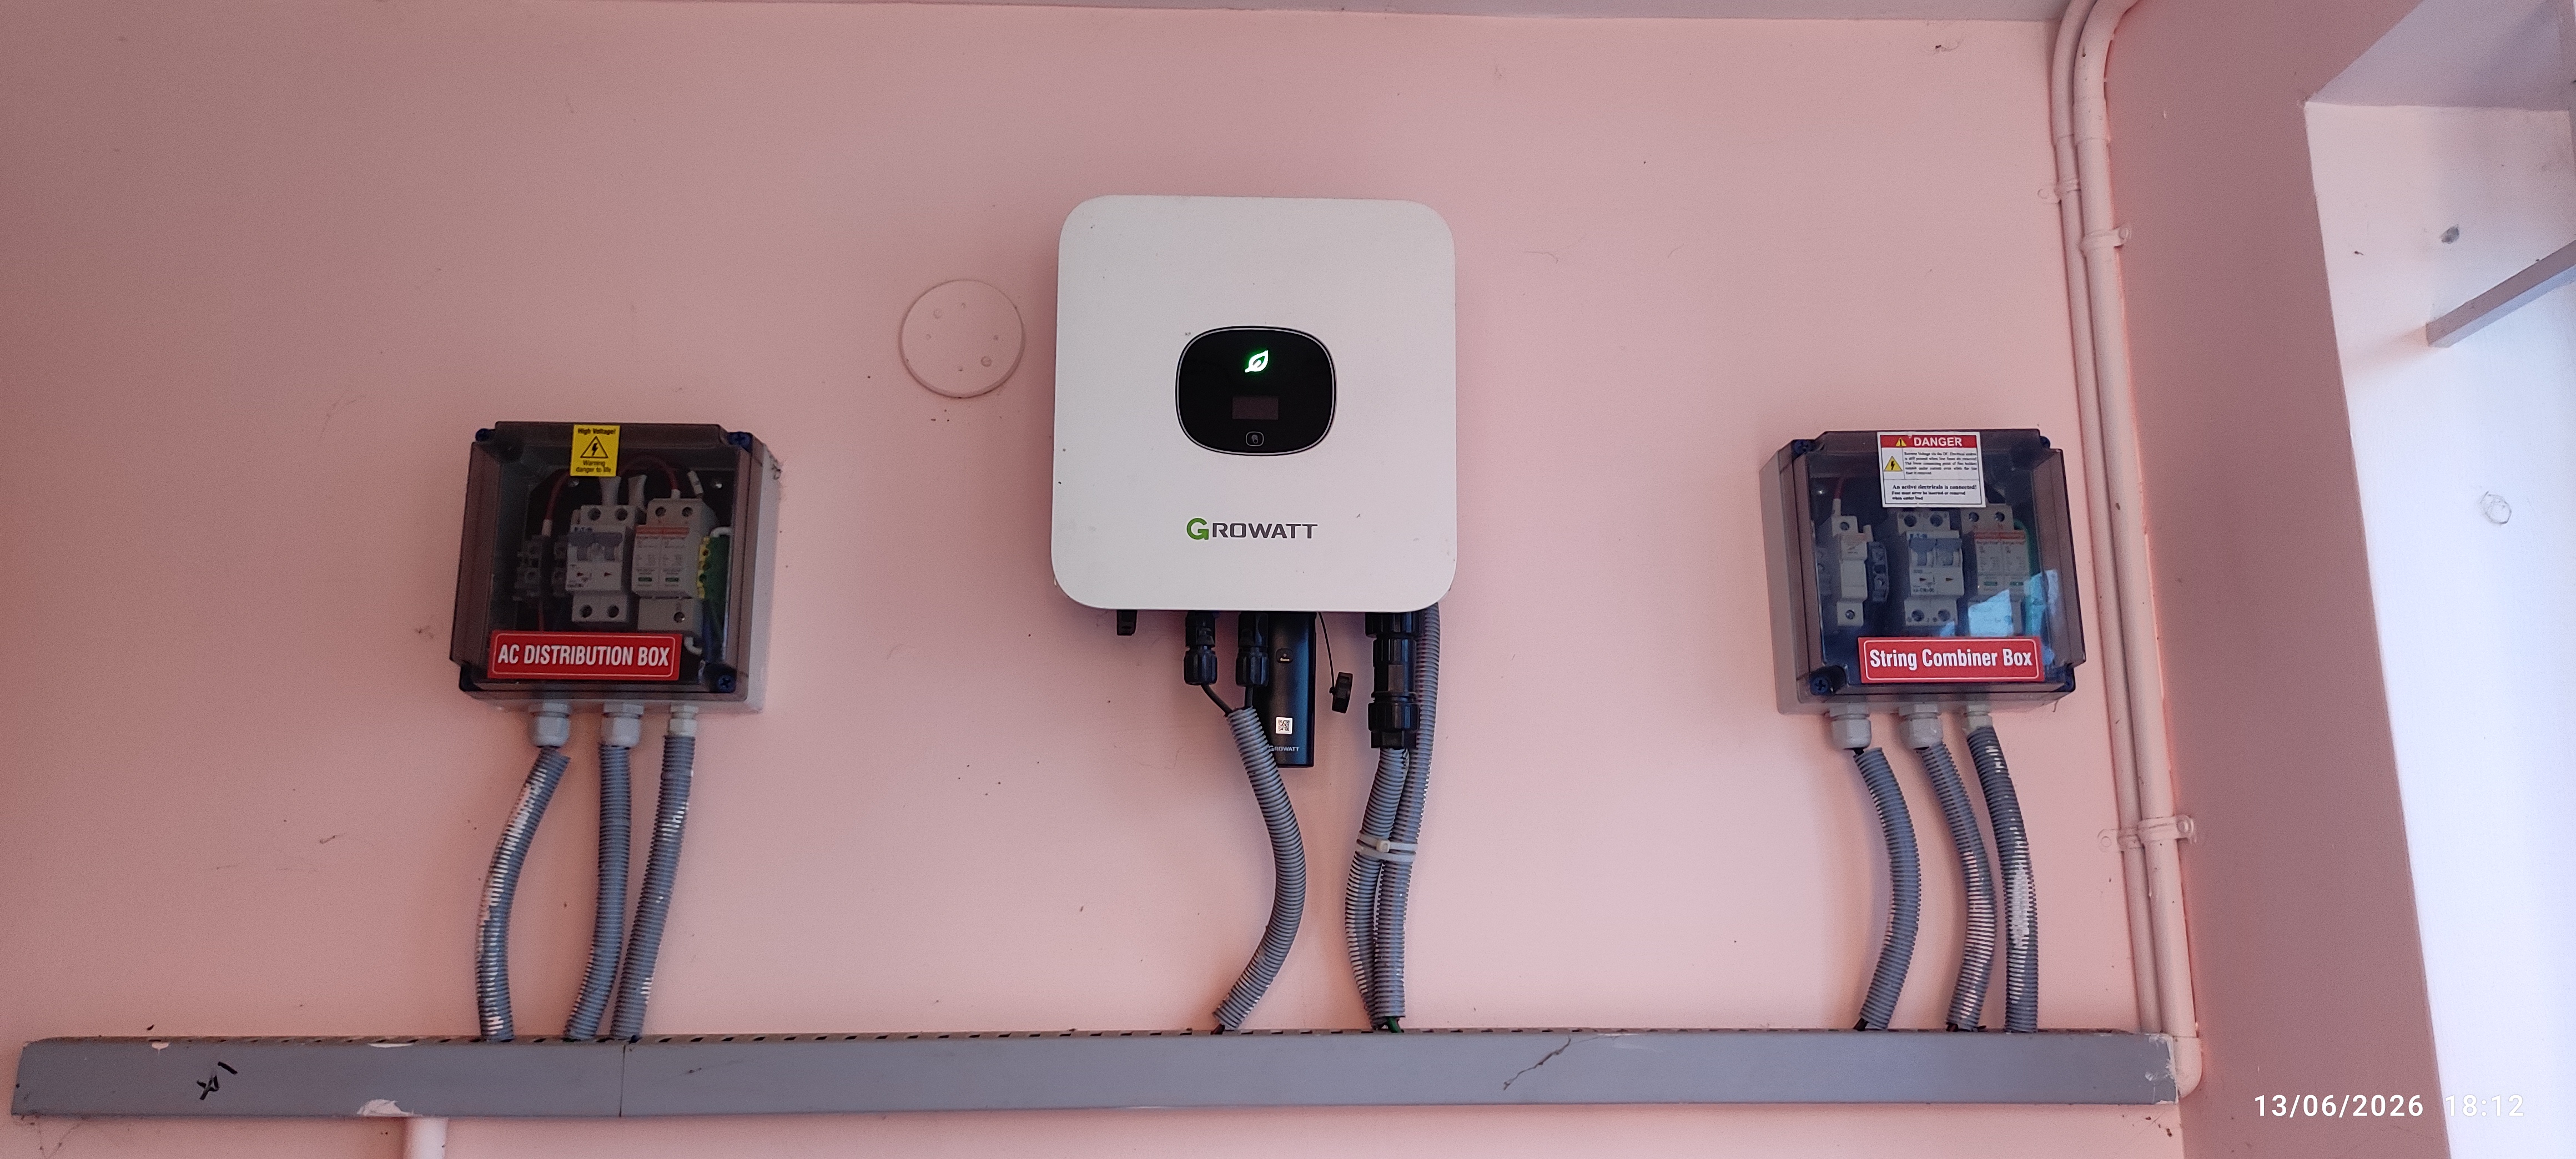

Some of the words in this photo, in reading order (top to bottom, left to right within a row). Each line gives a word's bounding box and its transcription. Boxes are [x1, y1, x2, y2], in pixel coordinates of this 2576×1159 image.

[1914, 437, 1963, 446] DANGER
[1186, 517, 1318, 540] GROWATT
[497, 644, 520, 664] AC
[524, 644, 633, 666] DISTRIBUTION
[637, 646, 670, 667] BOX
[1869, 649, 1918, 671] String
[1922, 649, 1998, 668] Combiner
[2003, 648, 2033, 667] Box
